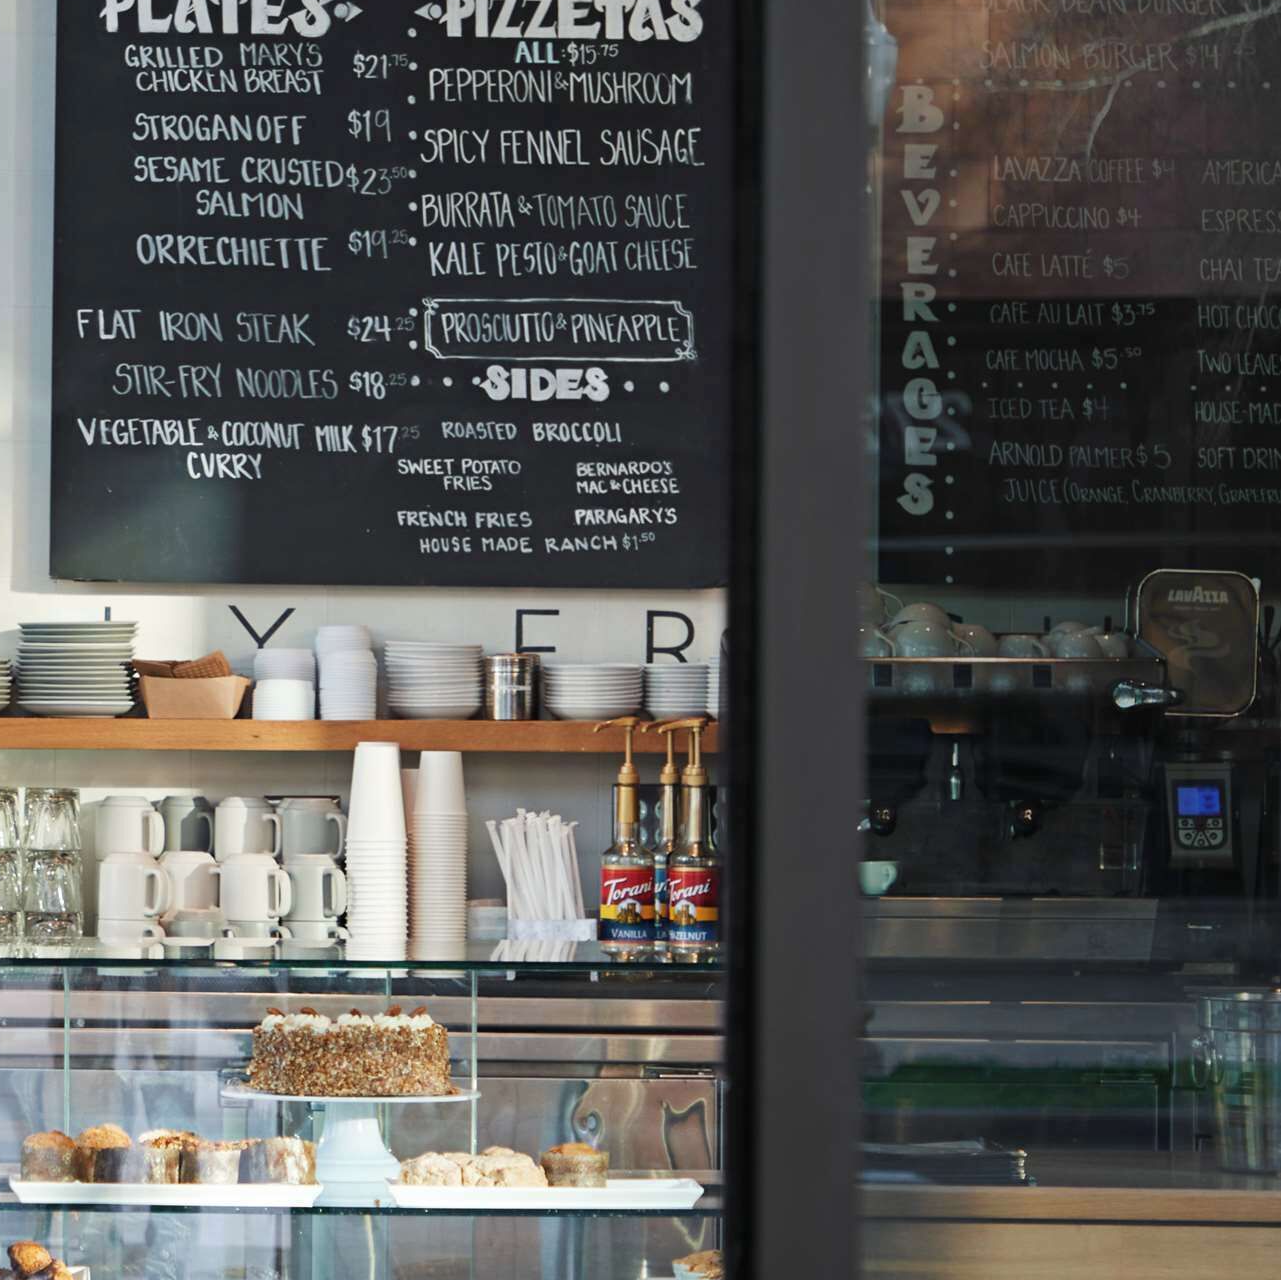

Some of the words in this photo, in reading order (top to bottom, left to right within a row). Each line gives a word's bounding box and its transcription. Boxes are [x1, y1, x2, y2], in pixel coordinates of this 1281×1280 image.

[124, 44, 223, 68] GRILLED
[136, 69, 238, 93] CHICKEN
[244, 69, 324, 95] BREAST
[429, 68, 552, 103] PEPPERONI
[570, 72, 692, 104] MUSHROOM
[132, 113, 306, 144] STROGANOFF
[420, 128, 489, 163] SPICY
[500, 129, 590, 165] FENNEL
[600, 128, 705, 166] SAUSAGE
[134, 156, 229, 183] SESAME
[241, 157, 344, 188] CRUSTED
[196, 189, 304, 220] SALMON
[421, 191, 515, 228] BURRATA
[533, 194, 617, 229] TOMATO
[625, 194, 690, 228] SAUCE
[136, 234, 332, 271] ORRECHIETTE
[429, 242, 486, 276] KALE
[496, 242, 558, 277] PESTO
[570, 241, 618, 275] GOAT
[624, 239, 696, 271] CHEESE
[77, 309, 141, 340] FLAT
[160, 311, 223, 342] IRON
[237, 312, 316, 346] STEAK
[441, 312, 555, 343] PROSCIUTTO
[572, 314, 681, 344] PINEAPPLE
[113, 364, 222, 398] STIR-FRY
[236, 368, 338, 399] NOODLES
[480, 365, 609, 401] SIDES
[77, 418, 204, 446] VEGETABLE
[222, 421, 304, 449] COCONUT
[315, 424, 357, 452] MILK
[441, 422, 517, 440] ROASTED
[533, 422, 621, 442] BROCCOLI
[187, 452, 262, 479] CURRY
[398, 459, 454, 475] SWEET
[462, 459, 521, 475] POTATO
[444, 476, 493, 491] FRIES
[576, 481, 607, 494] MAC
[622, 479, 679, 494] CHEESE
[397, 511, 467, 527] FRENCH
[476, 512, 532, 528] FRIES
[420, 537, 472, 553] HOUSE
[482, 537, 532, 553] MADE
[545, 536, 617, 552] RANCH
[604, 877, 652, 907] Torani
